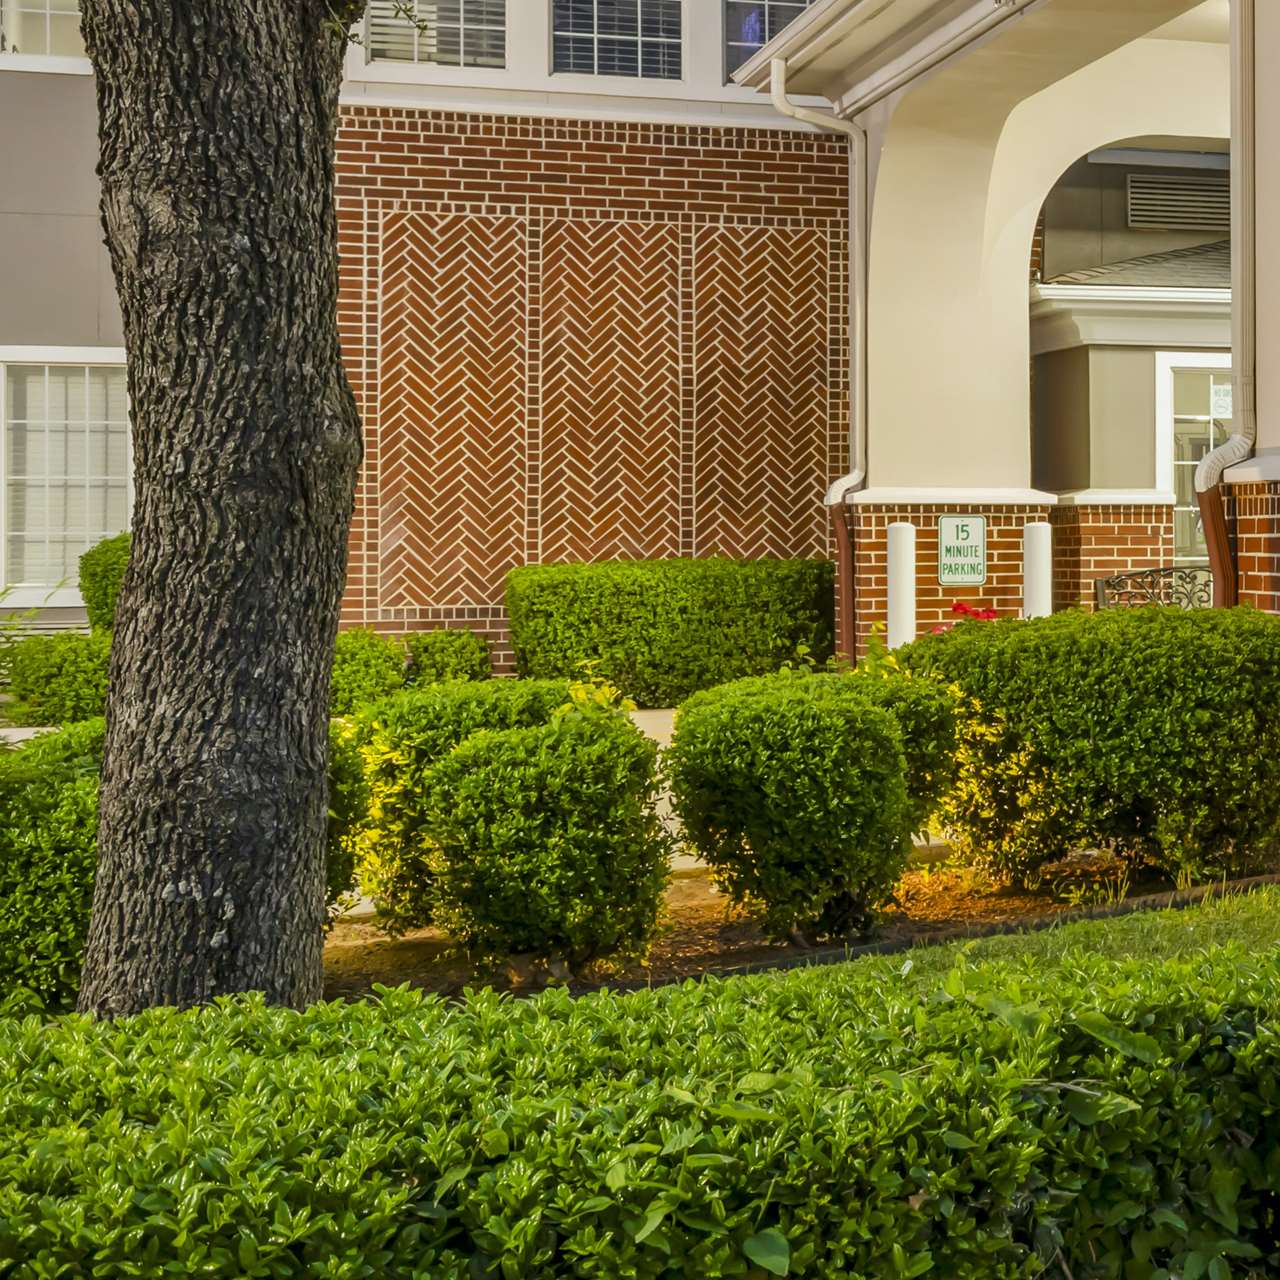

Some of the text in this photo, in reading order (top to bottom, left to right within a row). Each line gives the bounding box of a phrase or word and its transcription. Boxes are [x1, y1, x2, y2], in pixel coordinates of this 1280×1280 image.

[955, 524, 970, 541] 15
[945, 545, 980, 558] MINUTE
[942, 563, 982, 576] PARKING
